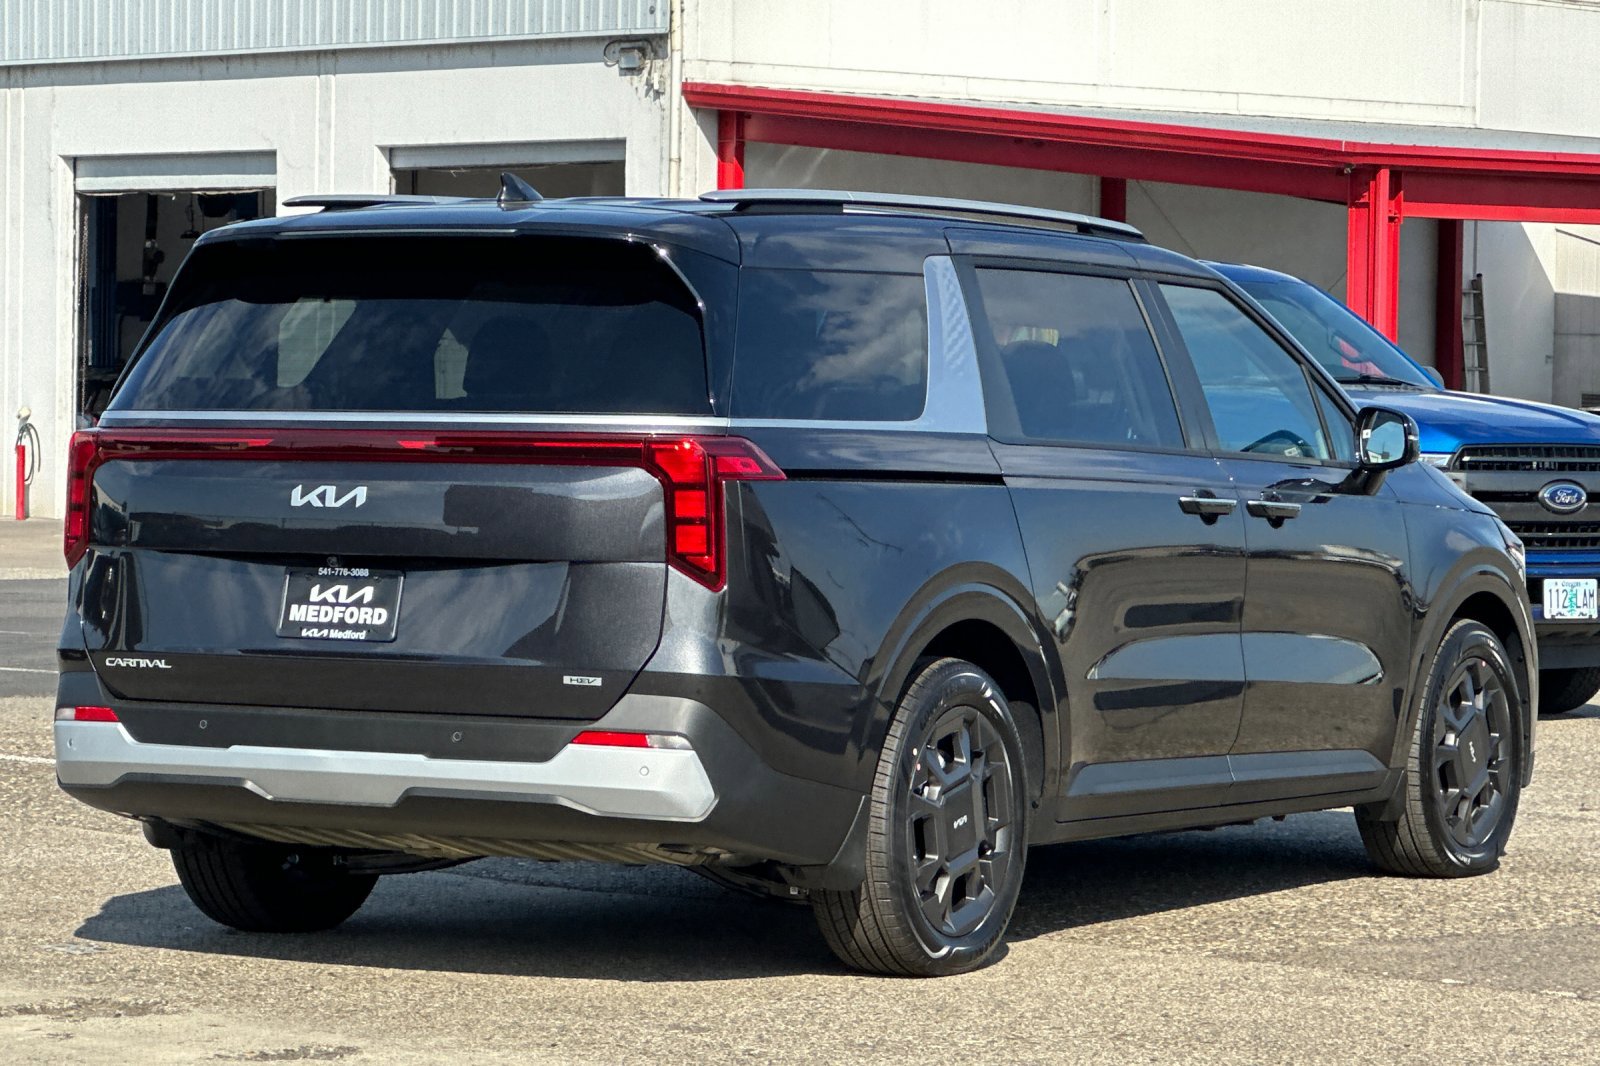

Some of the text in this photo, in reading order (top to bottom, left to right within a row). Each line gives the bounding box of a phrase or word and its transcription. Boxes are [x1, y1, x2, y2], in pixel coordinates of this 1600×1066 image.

[291, 484, 368, 508] KIA
[1555, 489, 1578, 503] Ford
[310, 584, 374, 603] KIA
[289, 604, 387, 625] MEDFORD
[329, 629, 367, 640] Medford
[105, 657, 172, 669] CARNIVAL
